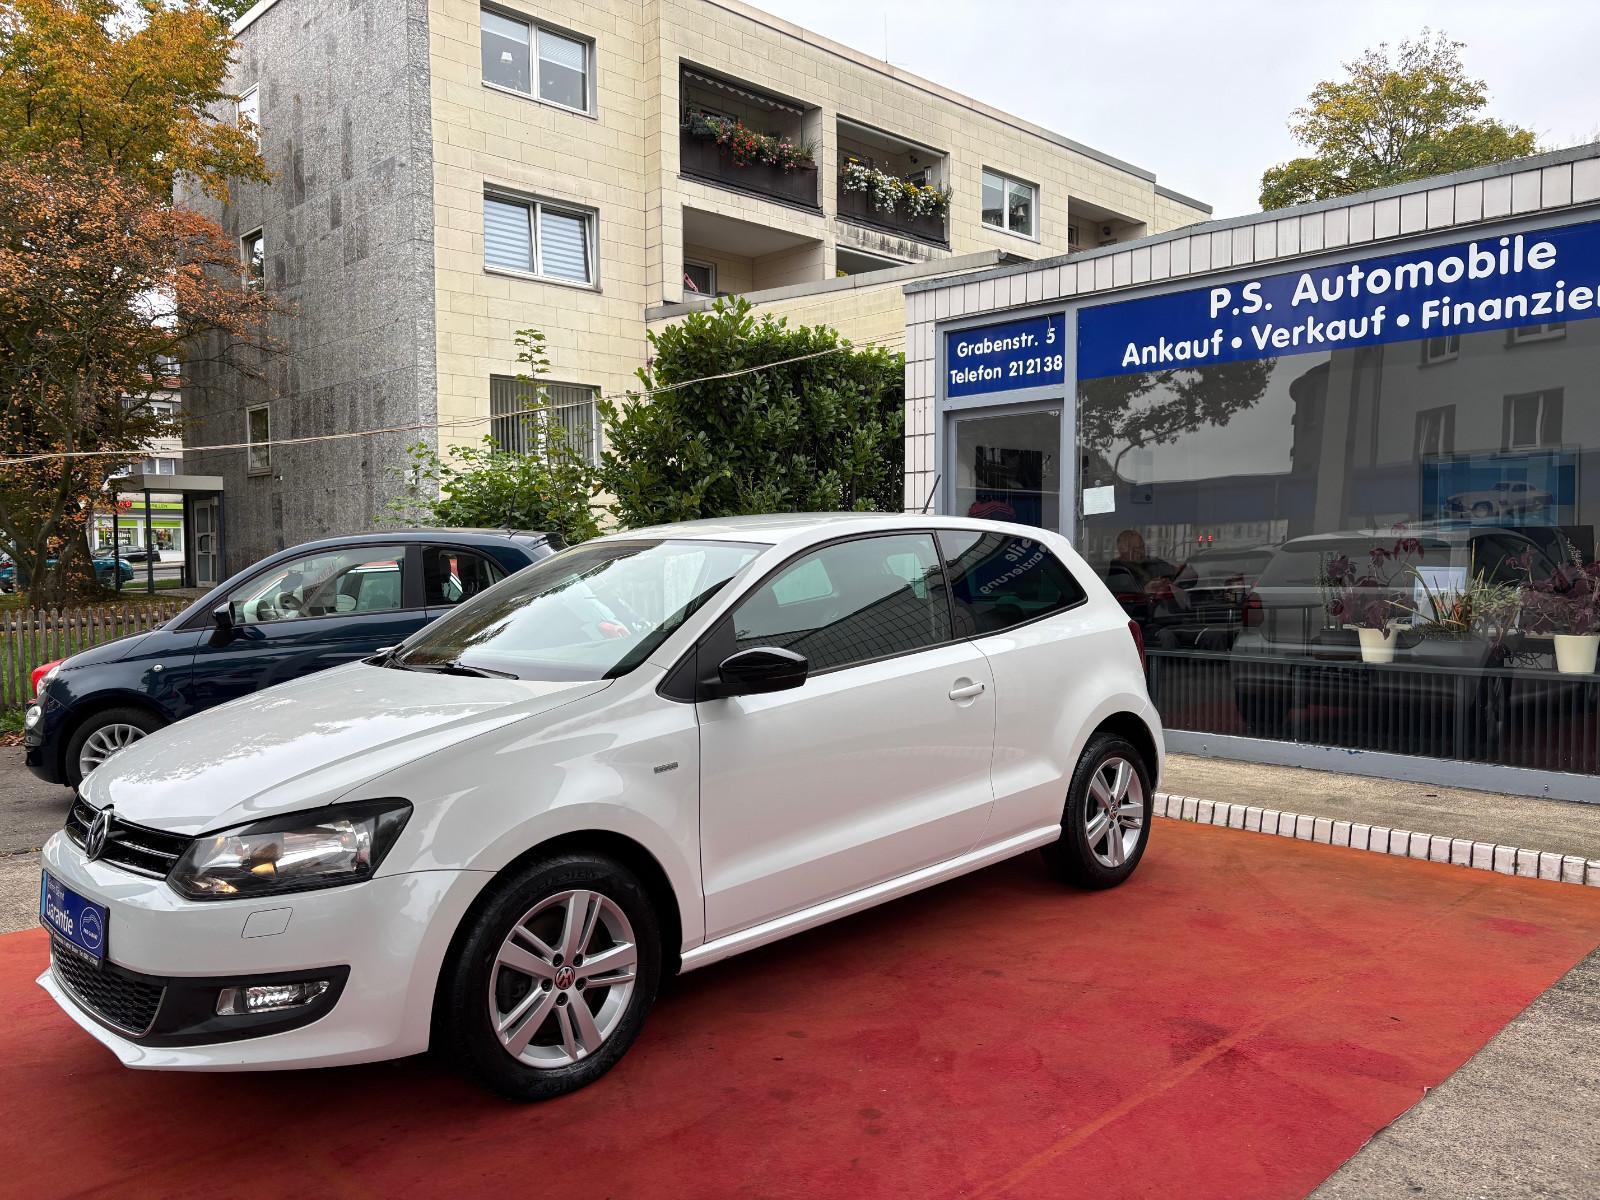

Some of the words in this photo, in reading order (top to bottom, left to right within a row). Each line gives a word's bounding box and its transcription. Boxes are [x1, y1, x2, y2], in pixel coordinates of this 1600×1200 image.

[1210, 281, 1273, 319] P.S.
[1291, 234, 1557, 307] Automobile
[956, 332, 1039, 358] Grabenstr.
[1045, 327, 1056, 344] 5
[1121, 328, 1223, 367] Ankauf
[1251, 305, 1386, 350] Verkauf
[1421, 279, 1600, 330] Finanzie
[950, 364, 1002, 385] Telefon
[46, 893, 74, 936] Garantie
